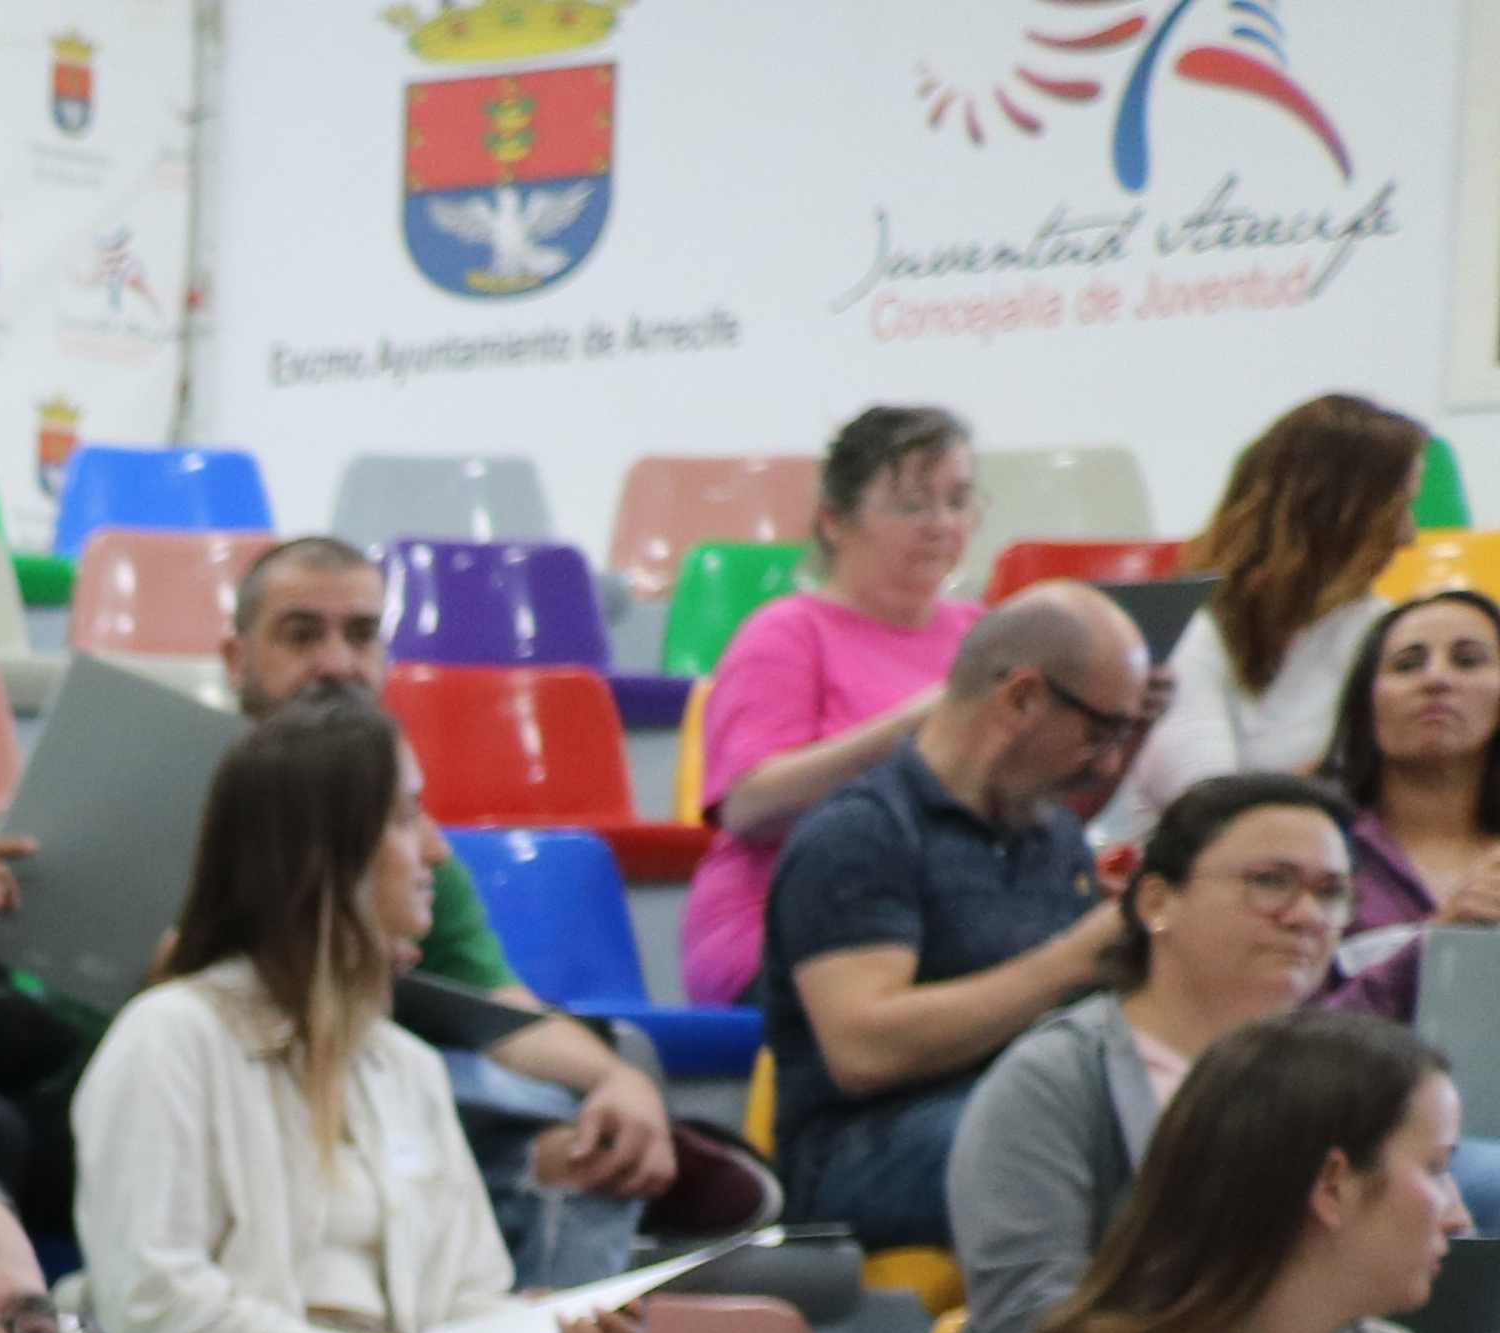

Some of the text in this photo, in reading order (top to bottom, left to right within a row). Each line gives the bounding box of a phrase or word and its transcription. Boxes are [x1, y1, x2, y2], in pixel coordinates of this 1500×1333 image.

[1077, 270, 1121, 326] de
[375, 321, 572, 388] Ayuntamiento
[582, 316, 614, 357] de
